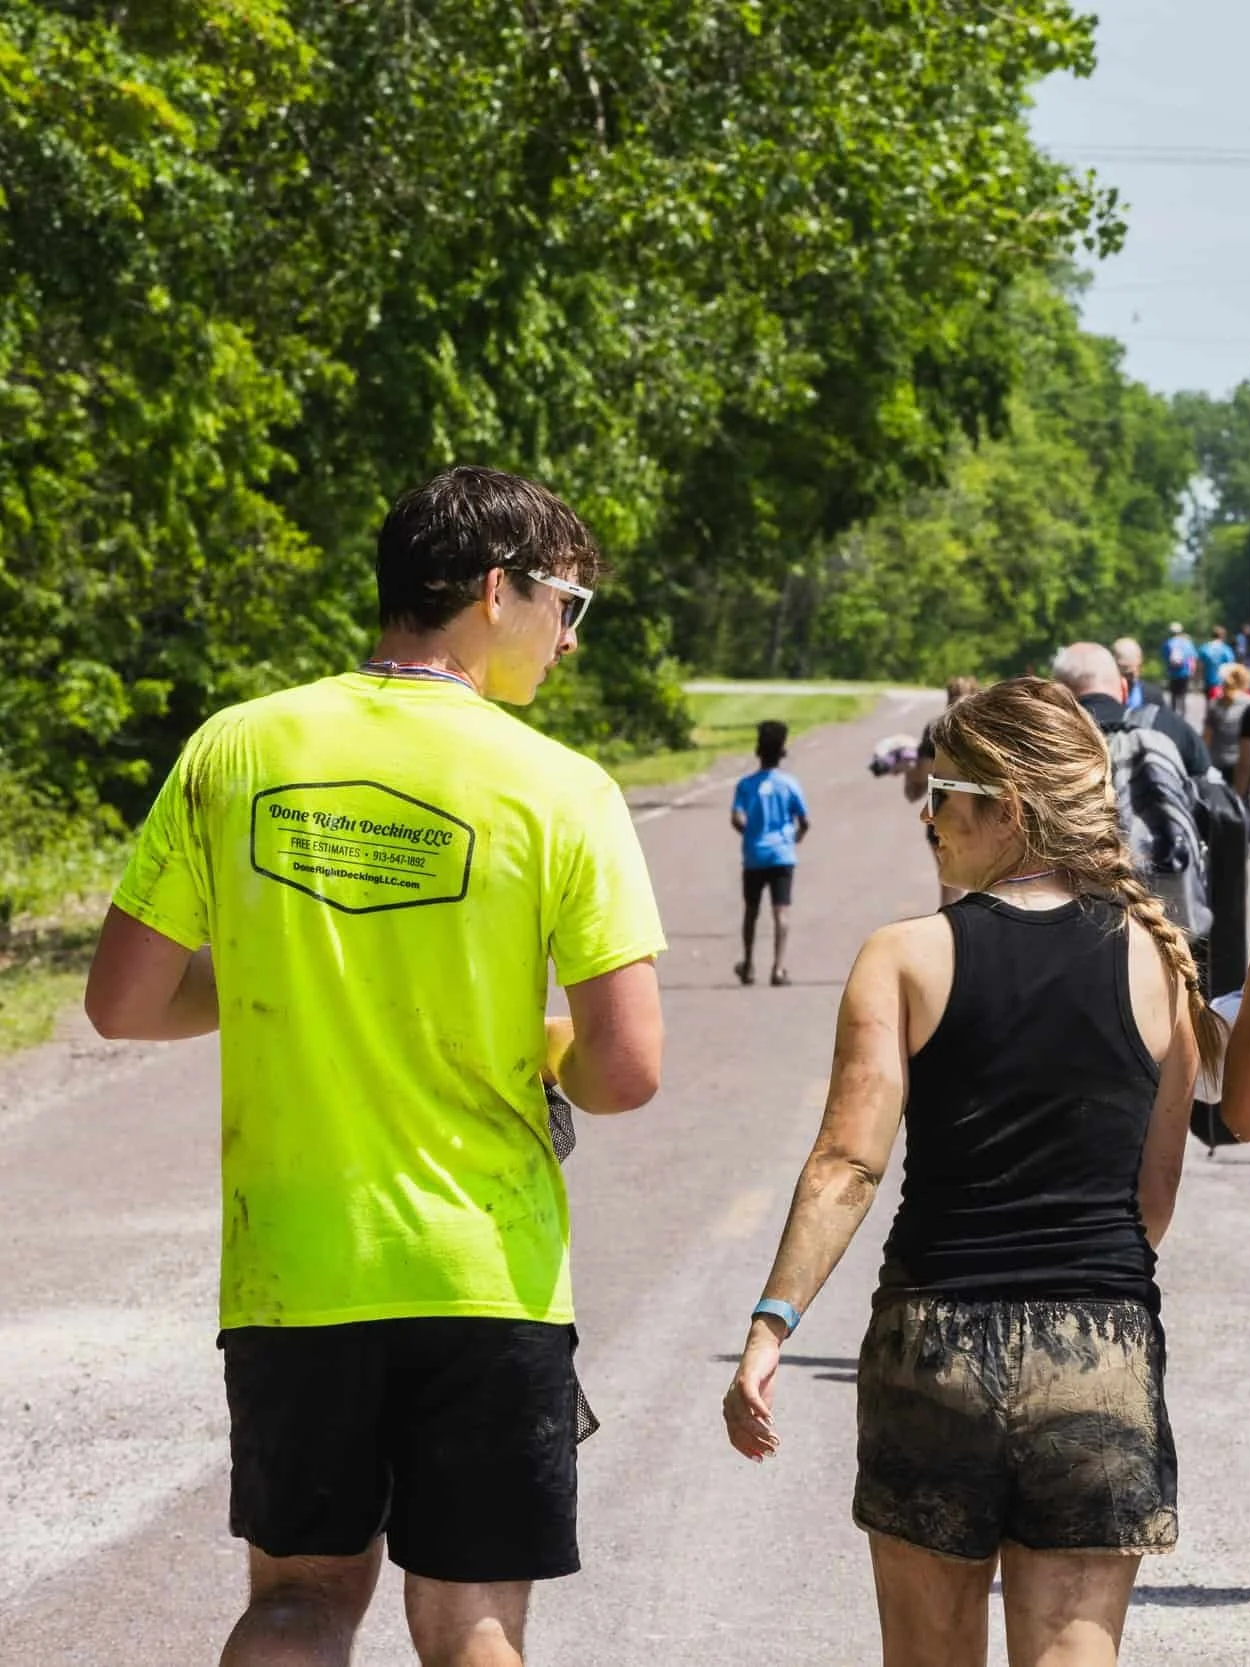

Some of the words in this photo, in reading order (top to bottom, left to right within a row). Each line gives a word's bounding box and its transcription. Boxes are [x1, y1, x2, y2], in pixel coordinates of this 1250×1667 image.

[269, 804, 309, 822] Done
[312, 811, 357, 832] Right
[359, 820, 422, 843] Decking
[422, 829, 453, 847] LLC
[291, 837, 311, 850] FREE
[312, 841, 361, 858] ESTIMATES
[293, 862, 420, 888] DoneRightDeckingLLC.com
